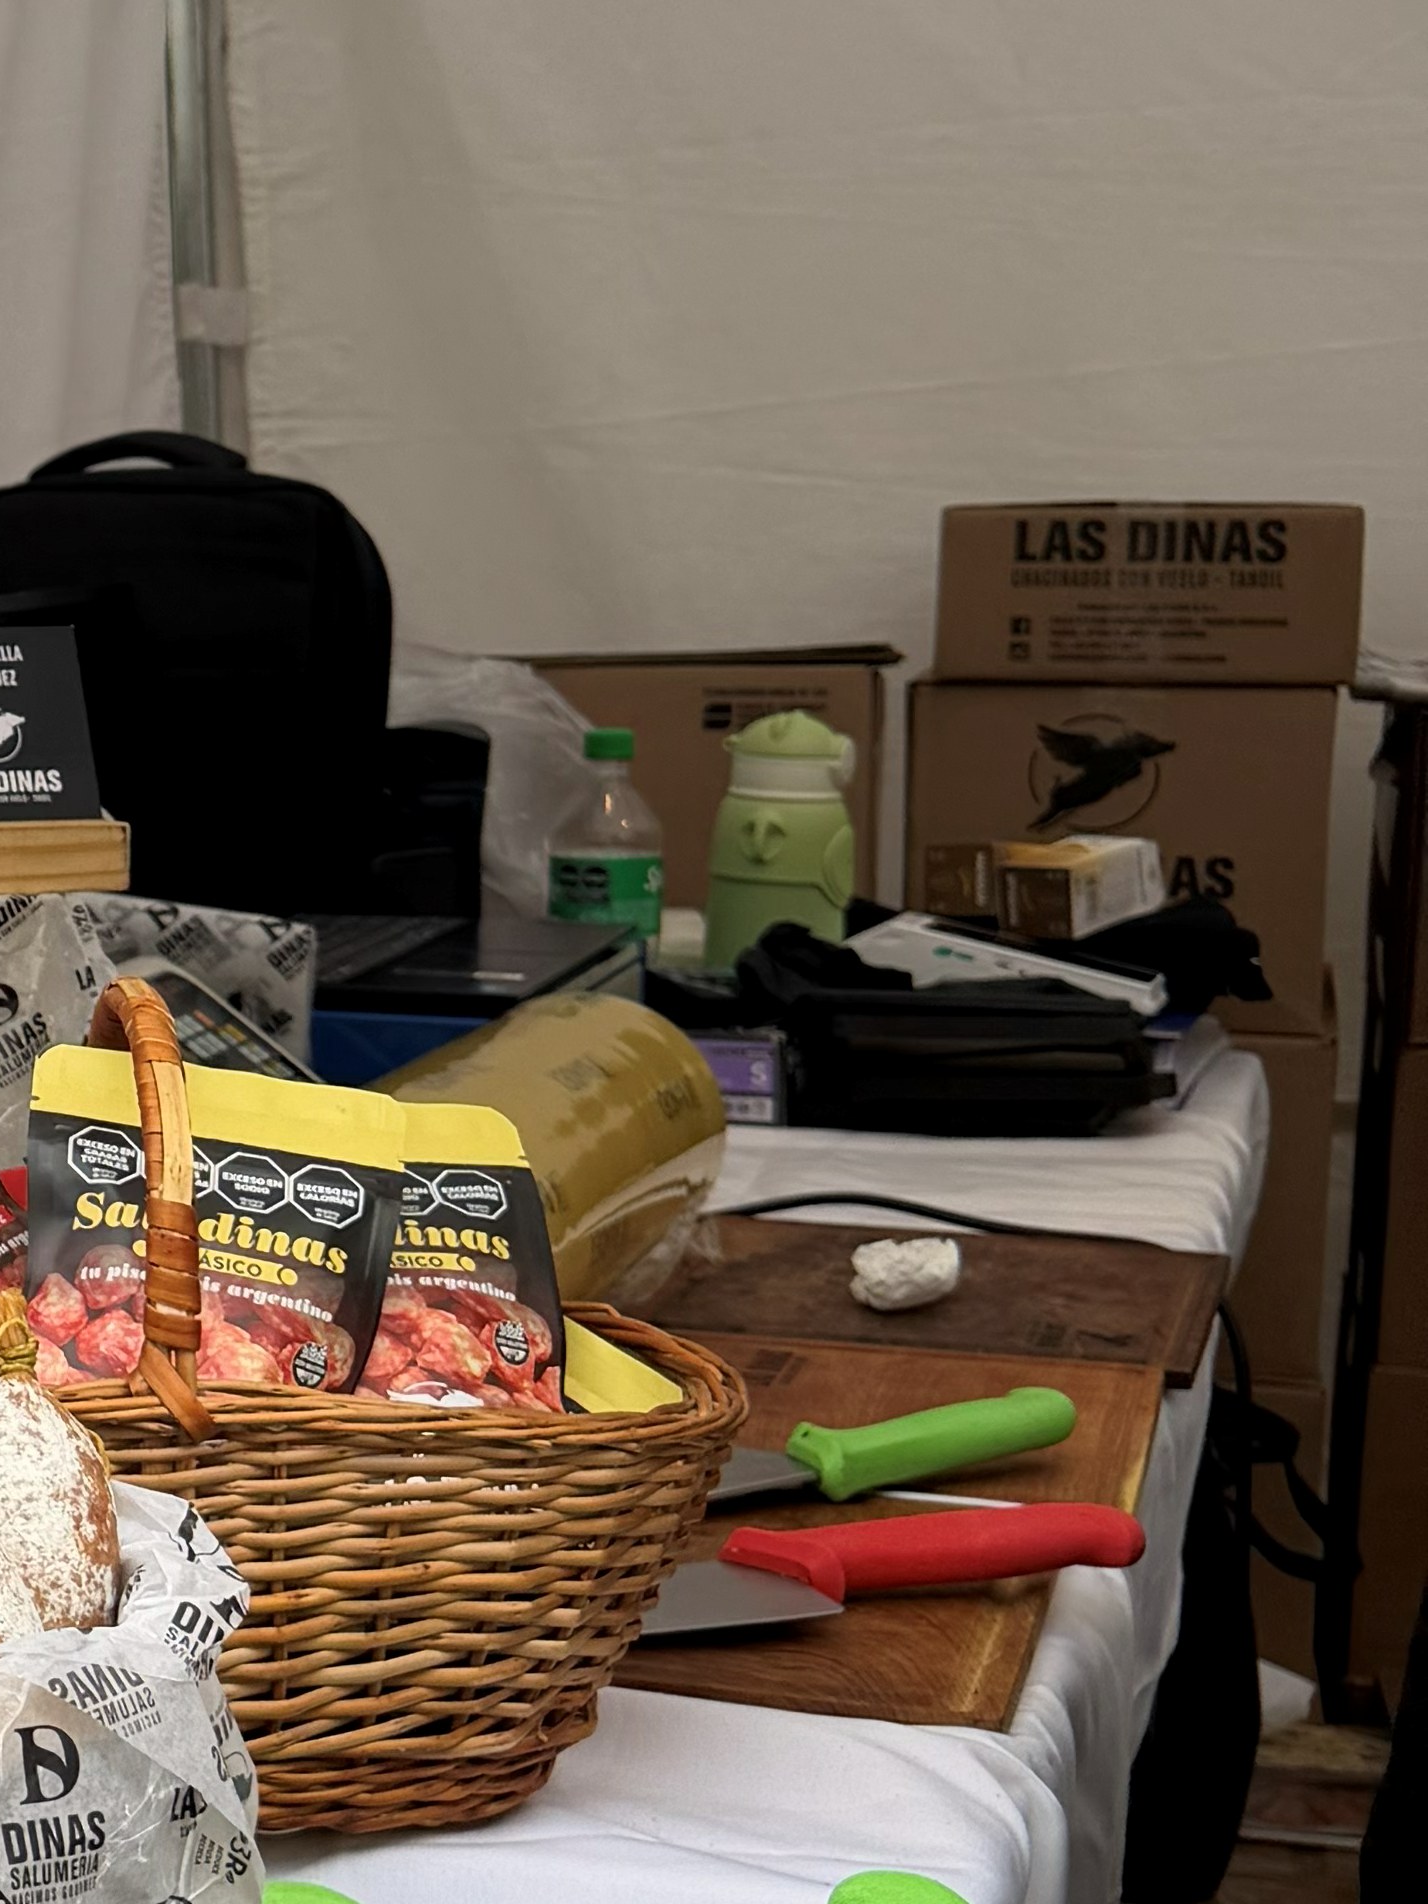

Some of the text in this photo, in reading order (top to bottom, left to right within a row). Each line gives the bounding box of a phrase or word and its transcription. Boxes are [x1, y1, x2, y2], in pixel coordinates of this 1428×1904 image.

[1014, 518, 1288, 564] LAS DINAS
[77, 1138, 135, 1158] EXCESO EN
[222, 1171, 283, 1189] EXCESO EN
[73, 1192, 349, 1274] Sadinas
[80, 1264, 333, 1323] tu argentino
[419, 1275, 516, 1301] argentino
[2, 1810, 106, 1866] DINAS
